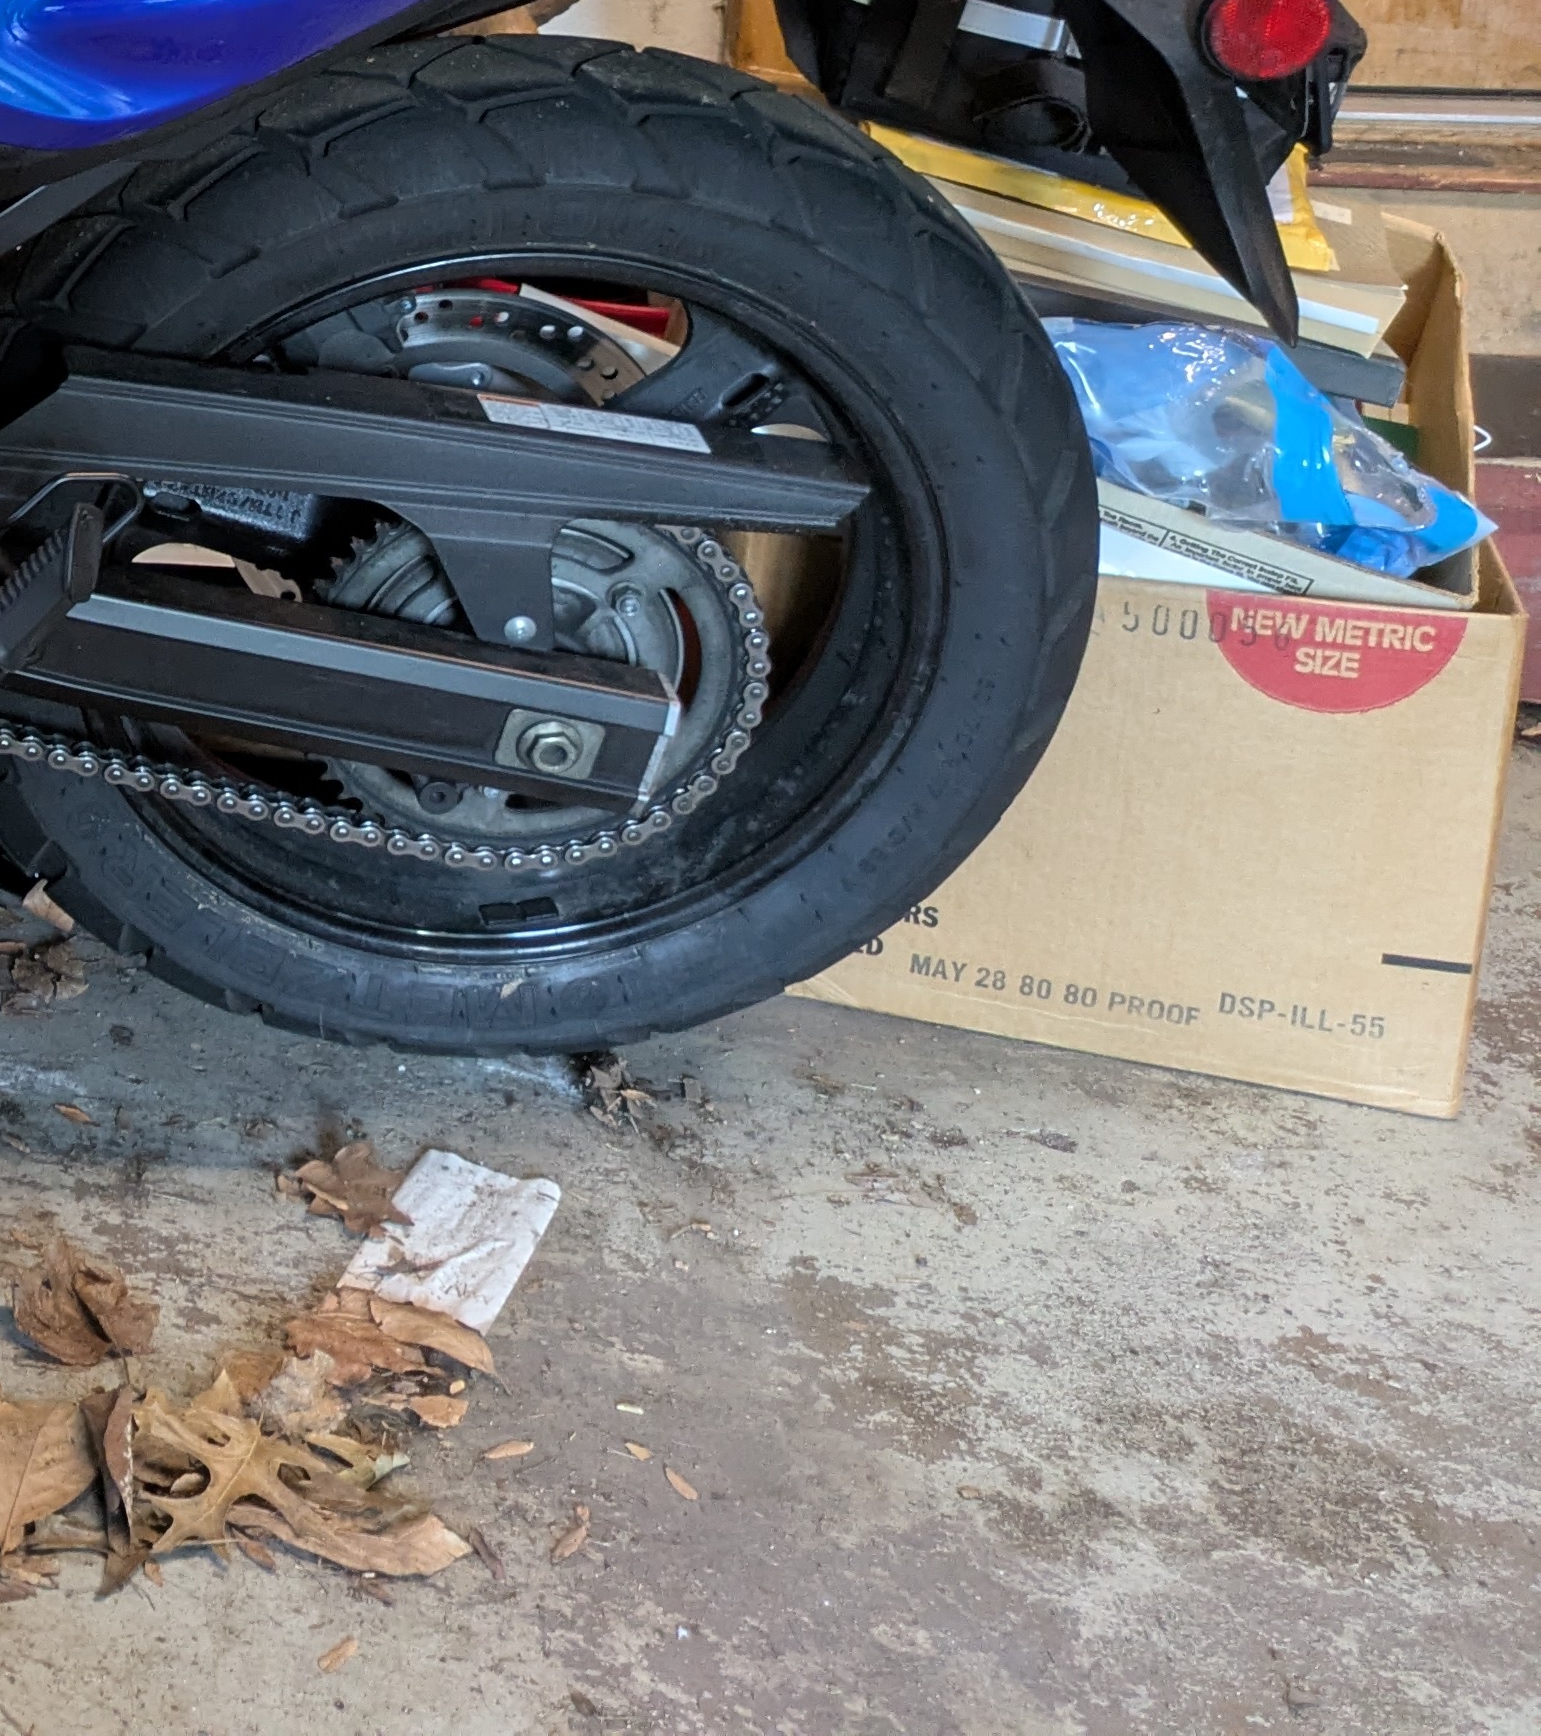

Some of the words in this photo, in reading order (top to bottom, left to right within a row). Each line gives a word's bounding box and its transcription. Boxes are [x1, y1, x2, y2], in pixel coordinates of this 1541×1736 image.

[1179, 538, 1209, 554] Getting
[1227, 554, 1258, 571] Correct
[1230, 608, 1309, 638] NEW
[1315, 616, 1435, 653] METRIC
[1294, 648, 1361, 679] SIZE
[910, 953, 967, 983] MAY
[975, 967, 1007, 992] 28
[1019, 975, 1052, 1000] 80
[1064, 983, 1097, 1008] 80
[1108, 992, 1201, 1027] PROOF
[1219, 993, 1386, 1040] DSP-ILL-55
